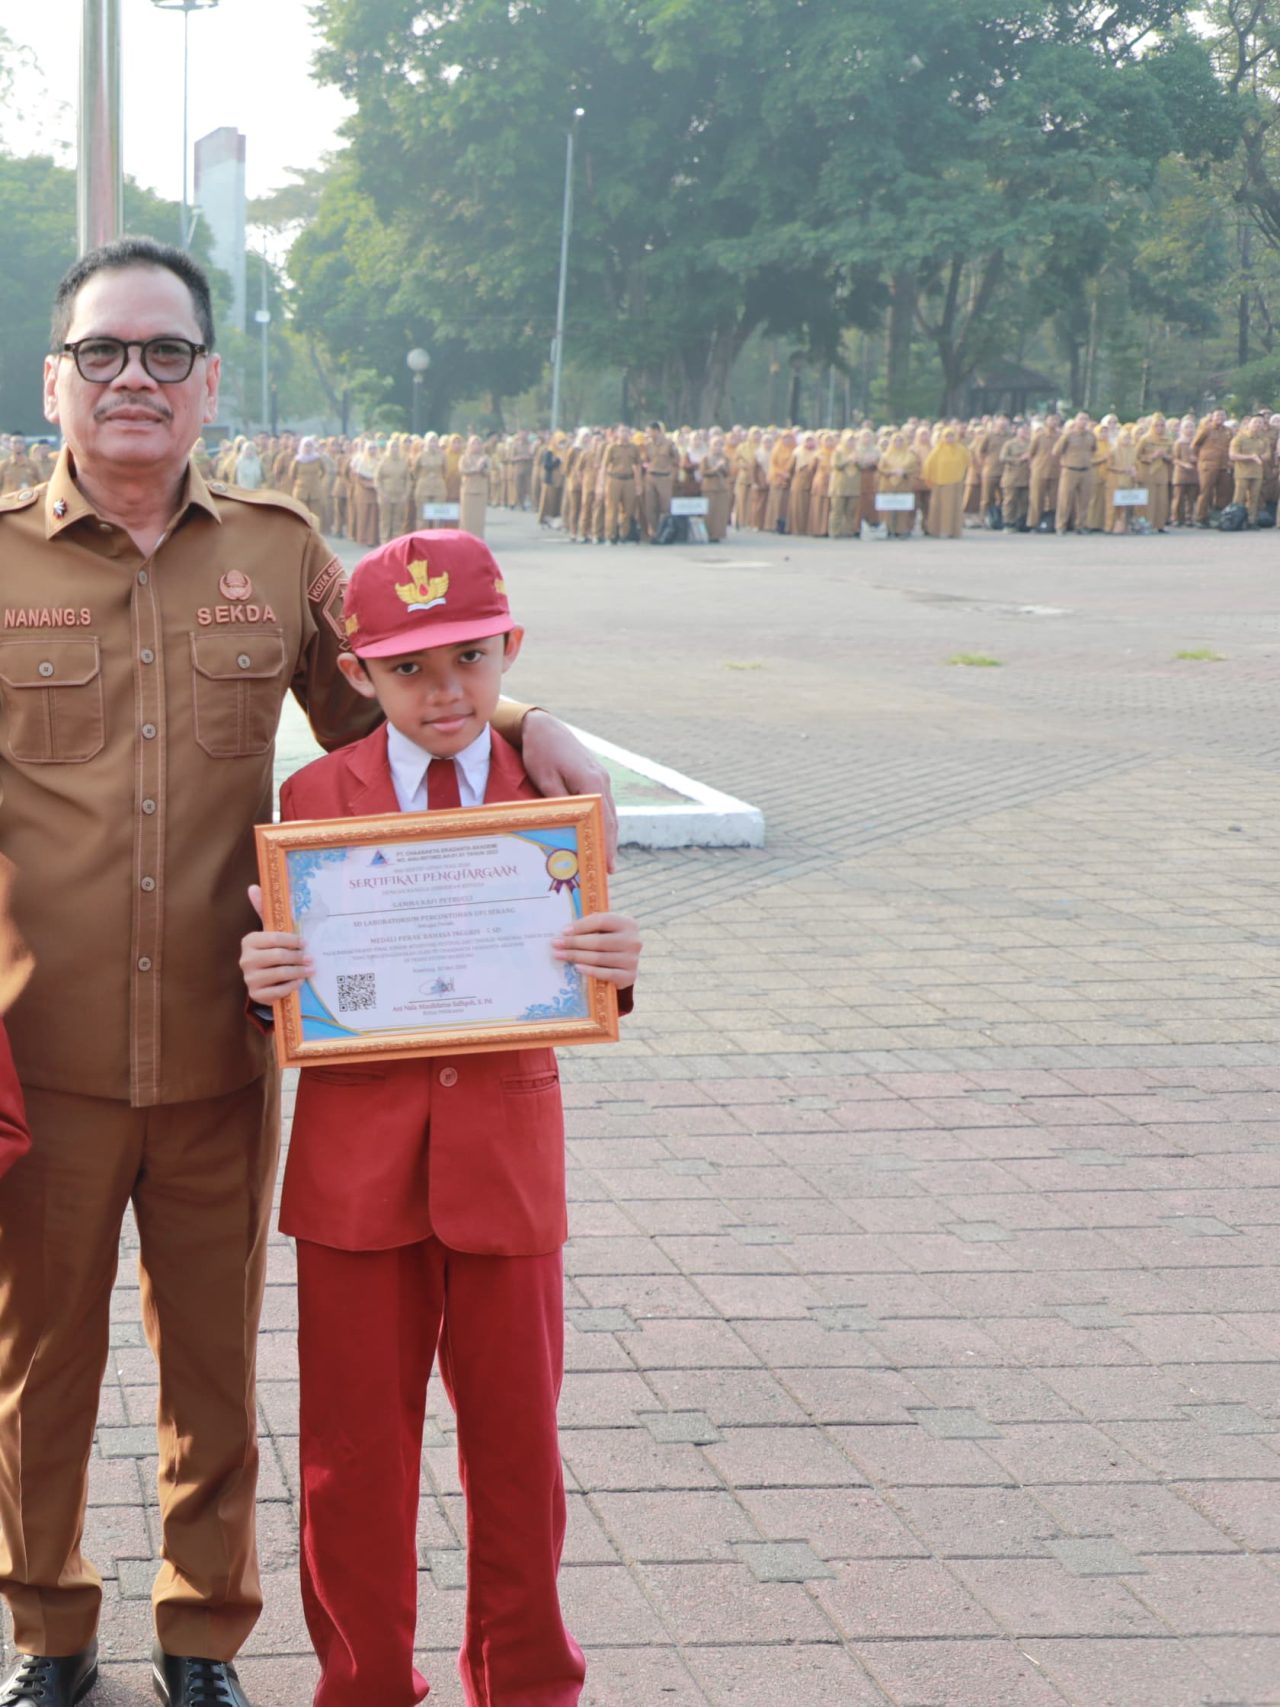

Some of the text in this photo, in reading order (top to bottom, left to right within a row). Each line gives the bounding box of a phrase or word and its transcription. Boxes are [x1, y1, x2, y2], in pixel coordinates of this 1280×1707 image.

[311, 574, 329, 597] KOTA
[4, 607, 91, 628] NANANG.S
[197, 604, 277, 625] SEKDA
[349, 872, 420, 889] SERTIFIKAT
[423, 865, 519, 883] PENGHARGAAN
